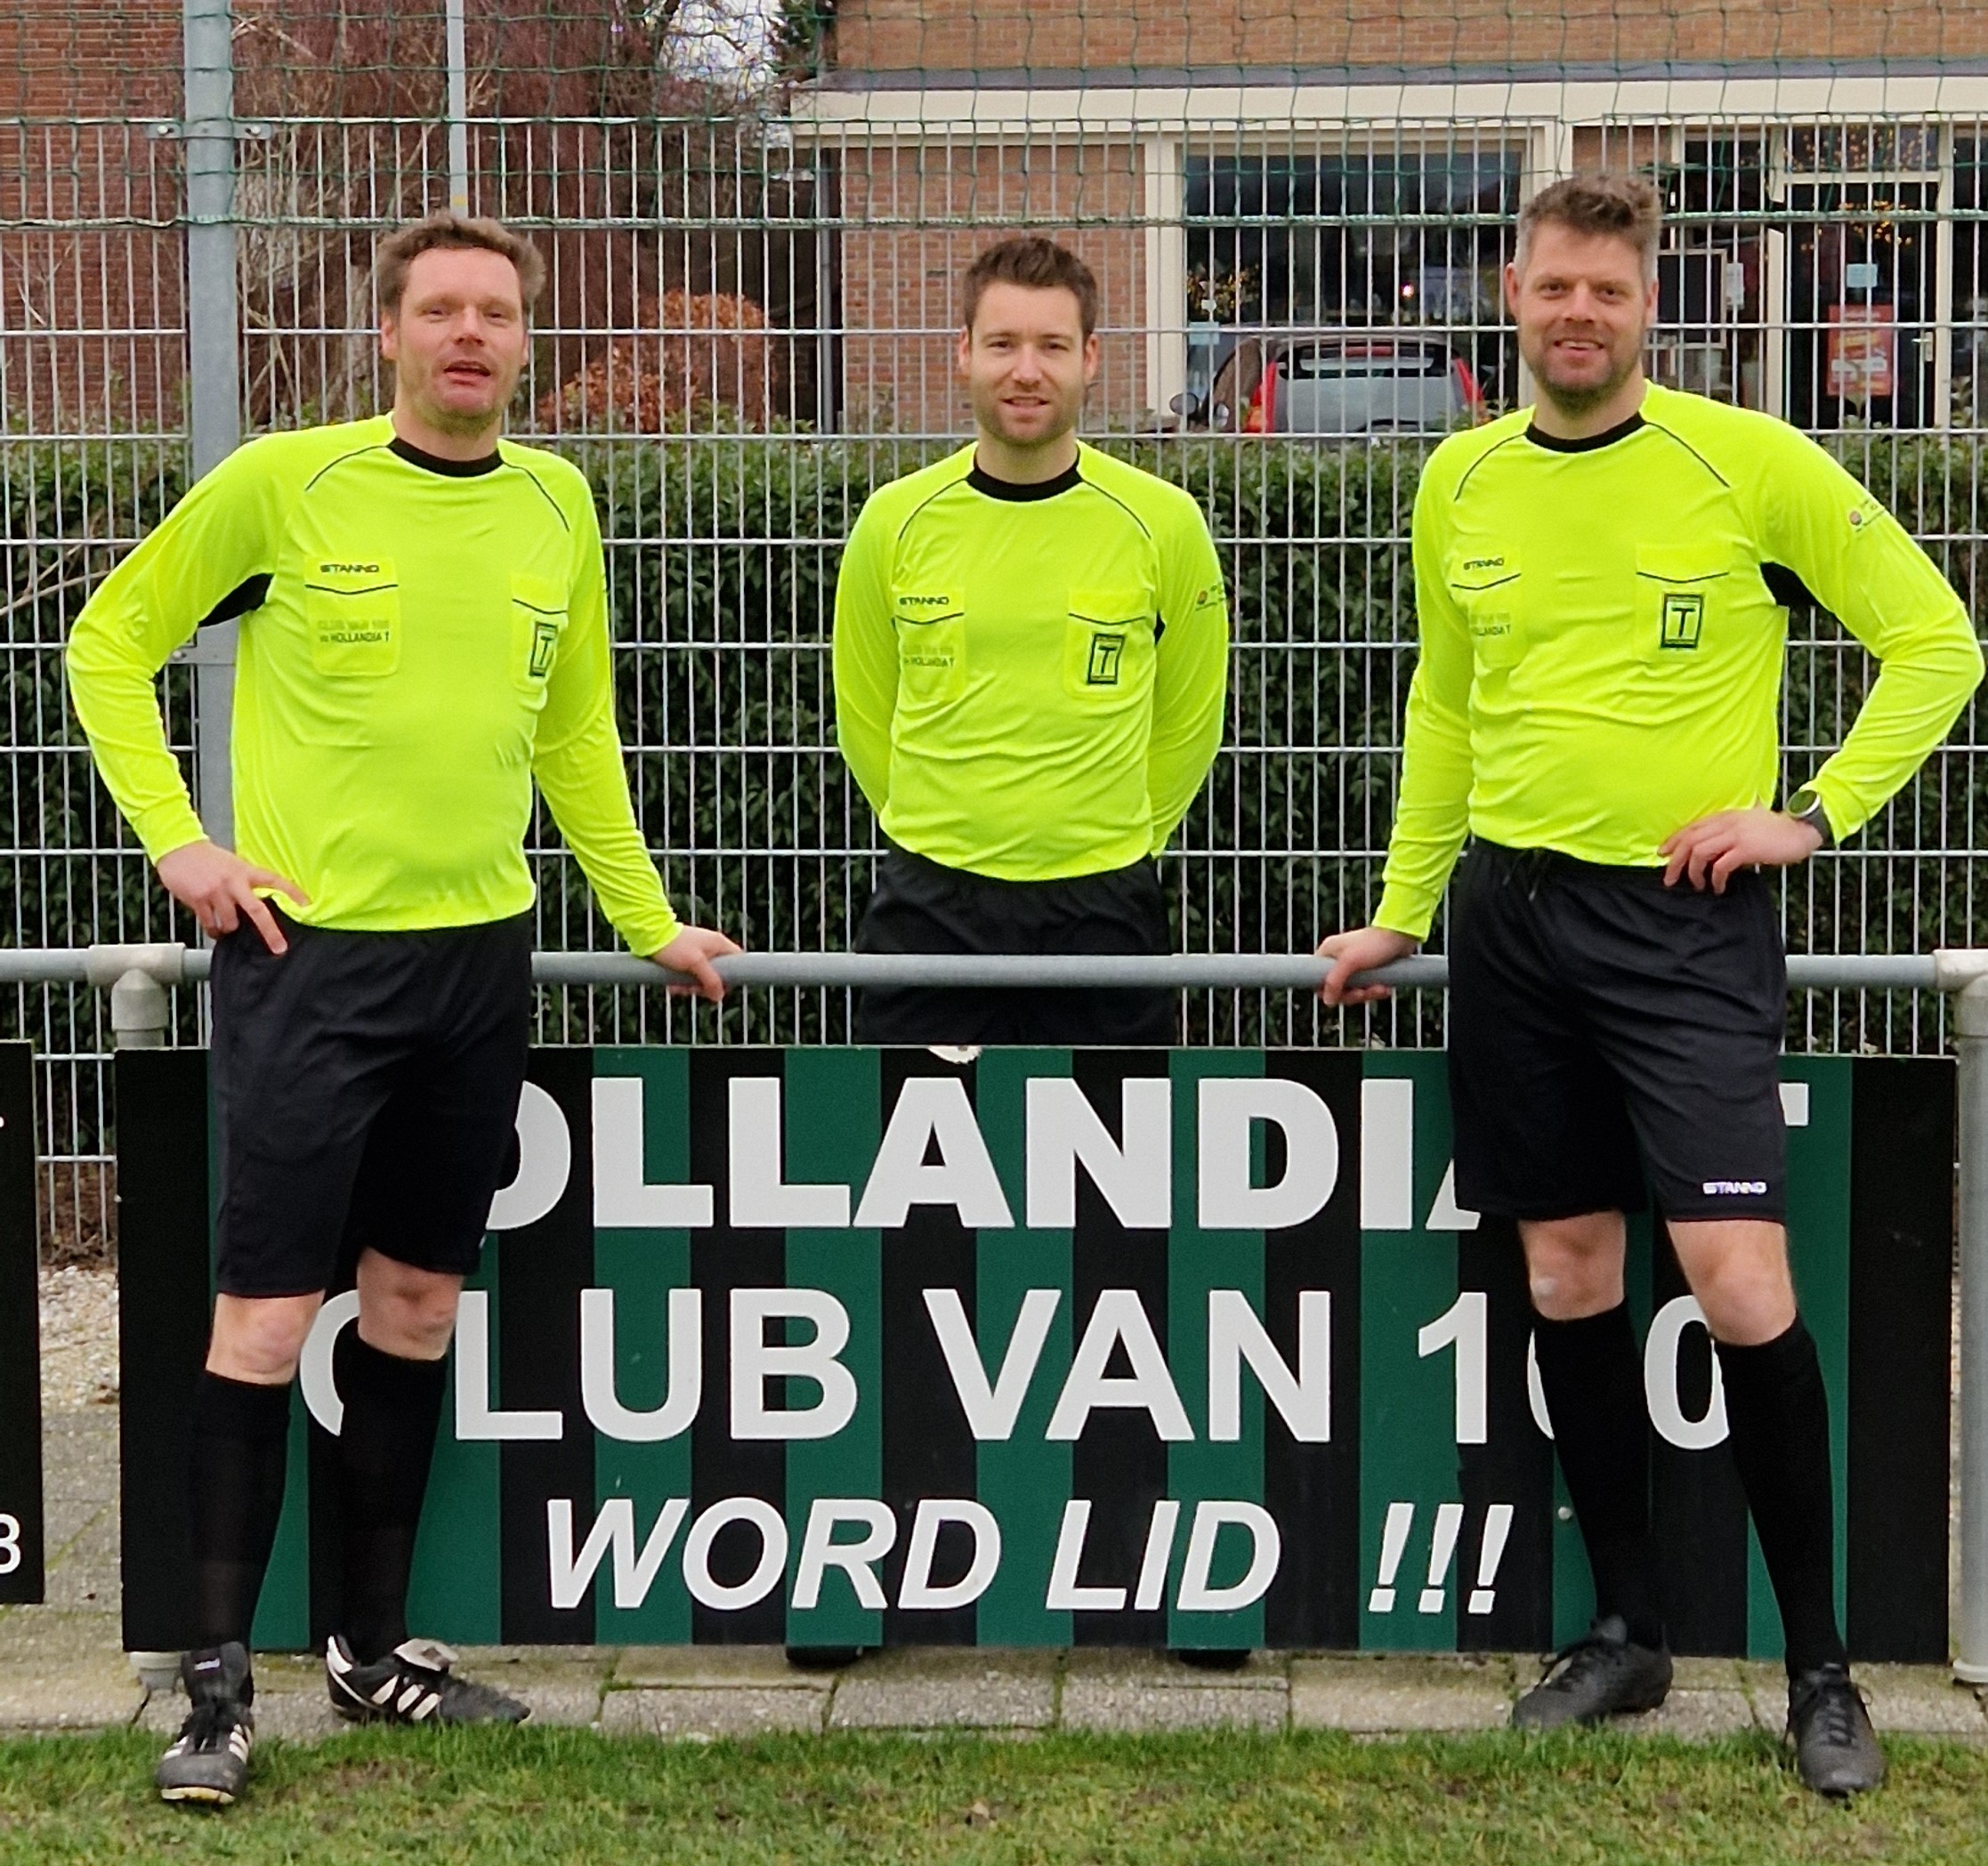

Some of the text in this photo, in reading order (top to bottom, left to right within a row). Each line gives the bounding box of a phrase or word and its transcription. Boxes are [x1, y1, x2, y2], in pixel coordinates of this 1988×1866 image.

[320, 563, 380, 573] STANNO
[486, 1077, 1481, 1231] OLLANDI
[1702, 1181, 1767, 1195] STANNO
[922, 1288, 1331, 1443] VAN
[1418, 1292, 1730, 1450] 10
[547, 1497, 1514, 1614] WORD LID !!!
